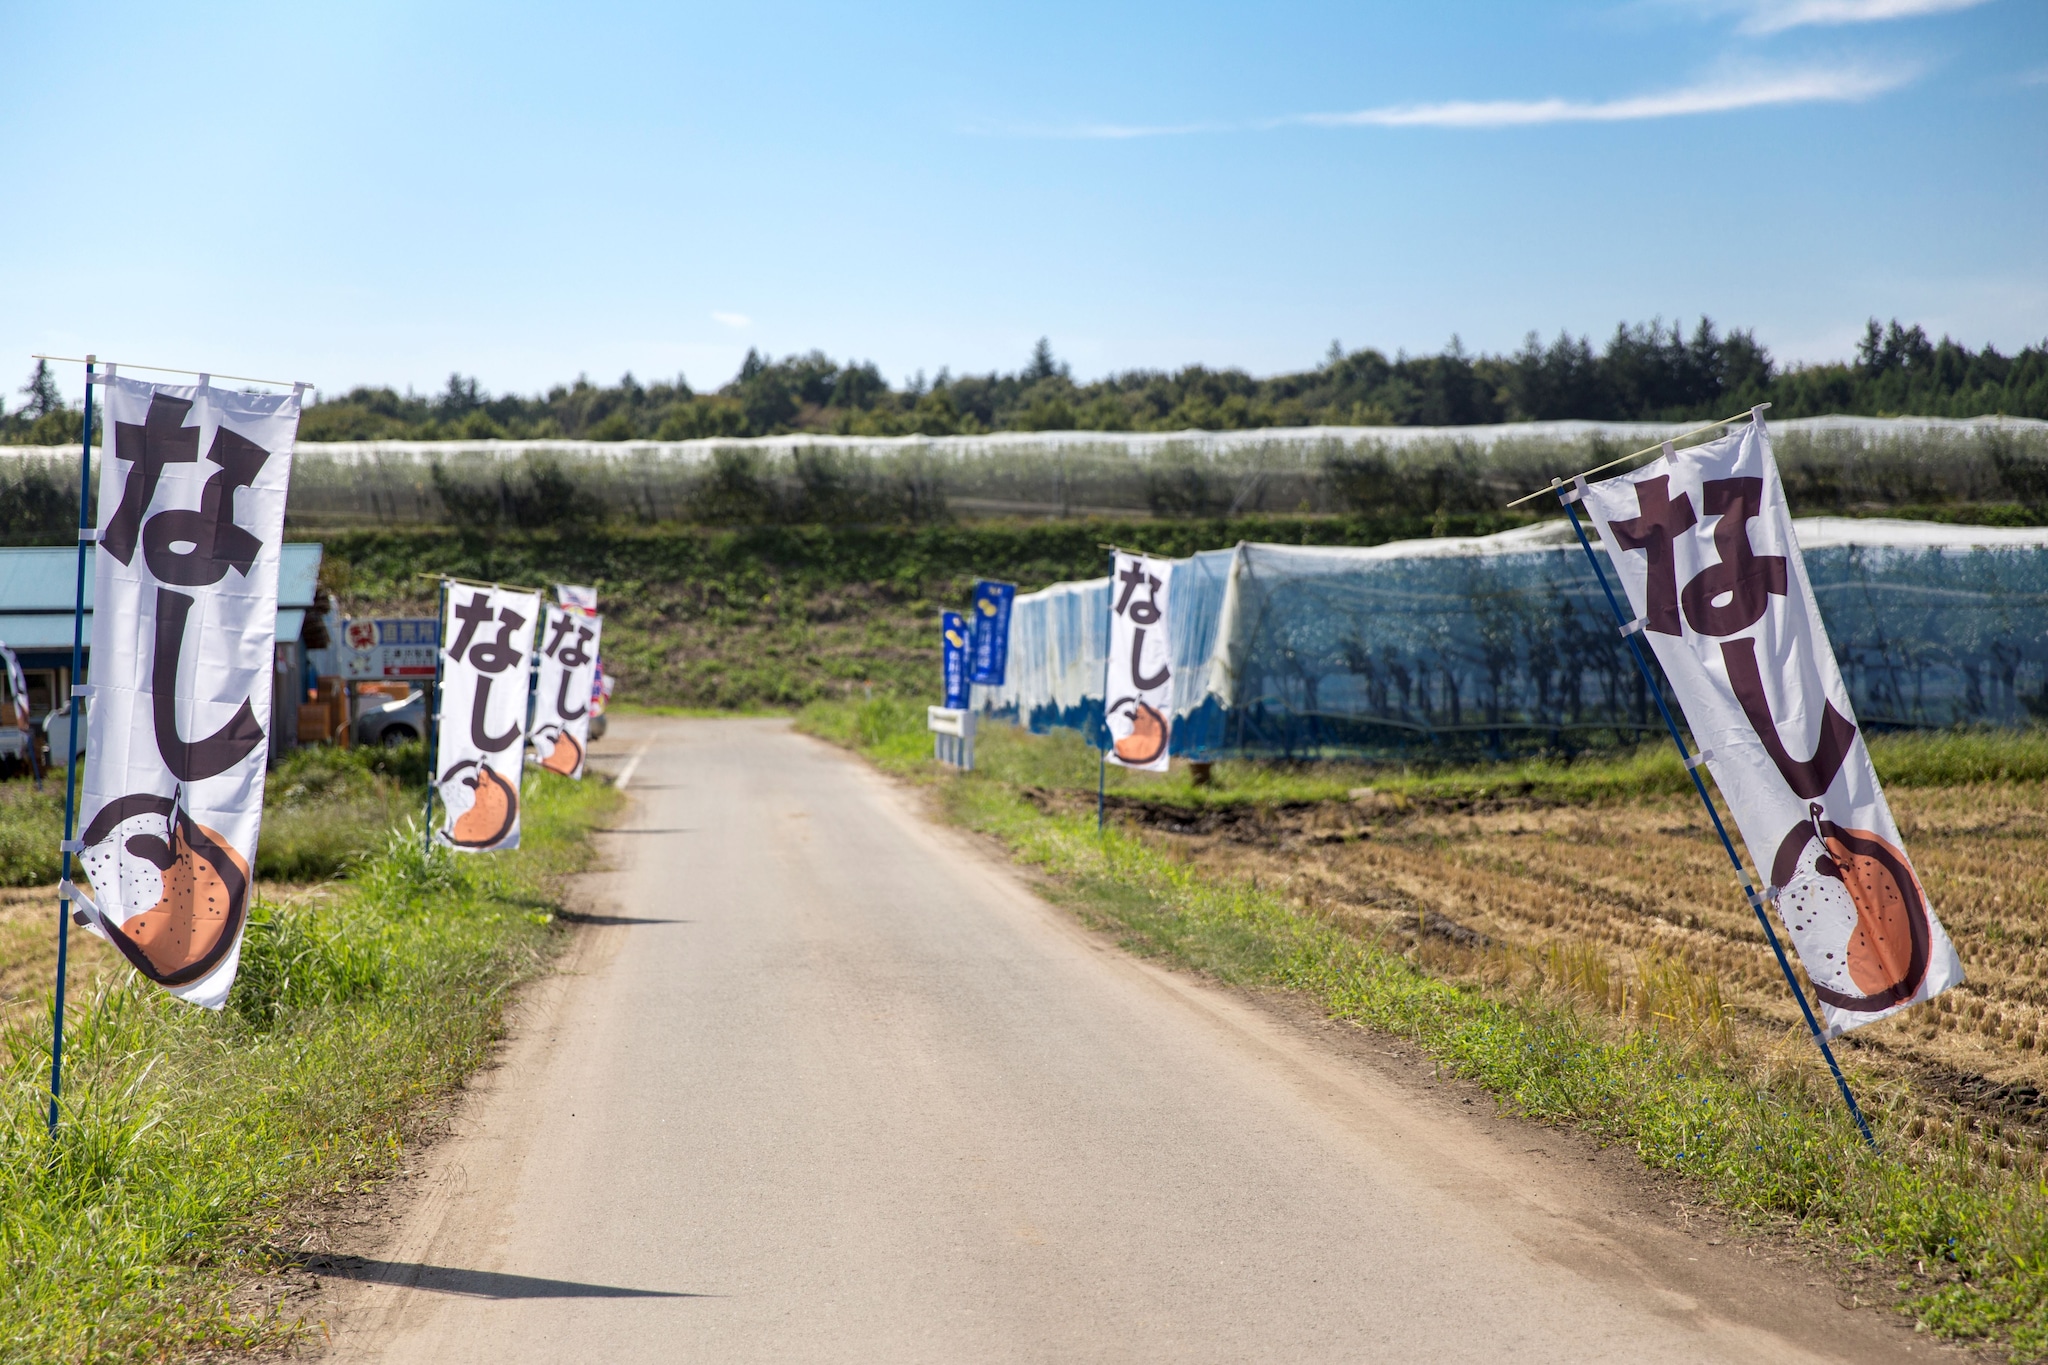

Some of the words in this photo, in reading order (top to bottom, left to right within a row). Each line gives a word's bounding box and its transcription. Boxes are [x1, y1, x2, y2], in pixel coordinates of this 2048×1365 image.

[100, 392, 271, 782] なし
[349, 622, 376, 650] 梨
[1115, 561, 1171, 691] なし
[1608, 474, 1856, 800] なし
[448, 592, 526, 752] なし
[545, 614, 594, 721] なし
